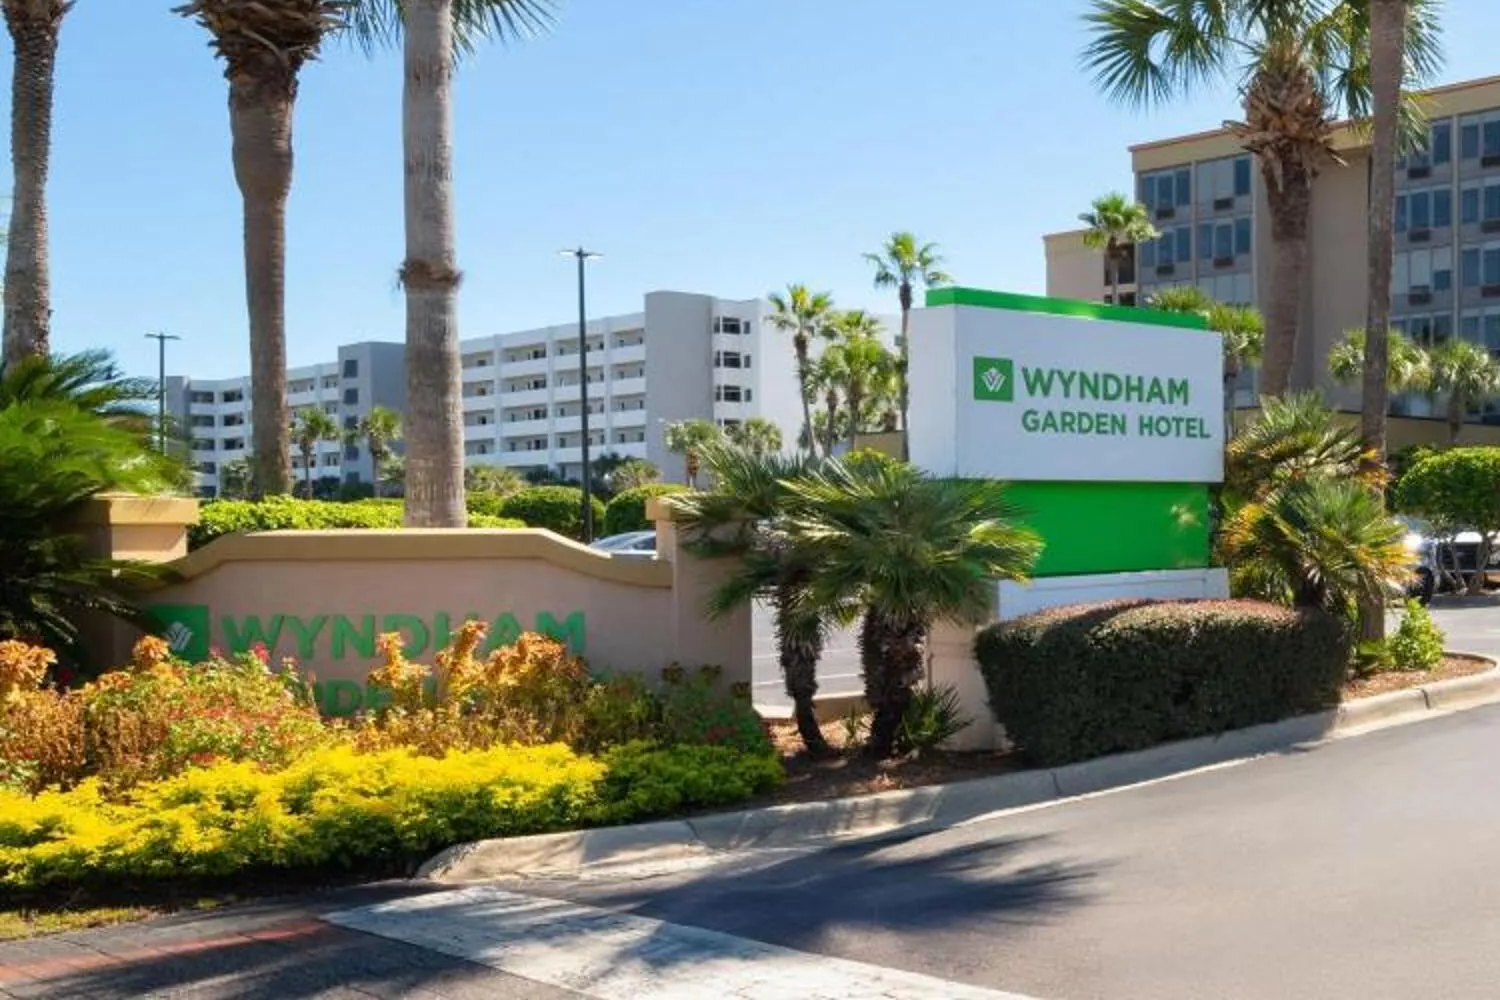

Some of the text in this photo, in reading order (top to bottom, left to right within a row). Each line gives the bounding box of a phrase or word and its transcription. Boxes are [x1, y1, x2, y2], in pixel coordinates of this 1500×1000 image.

[1021, 367, 1189, 405] WYNDHAM
[1021, 409, 1211, 439] GARDEN HOTEL
